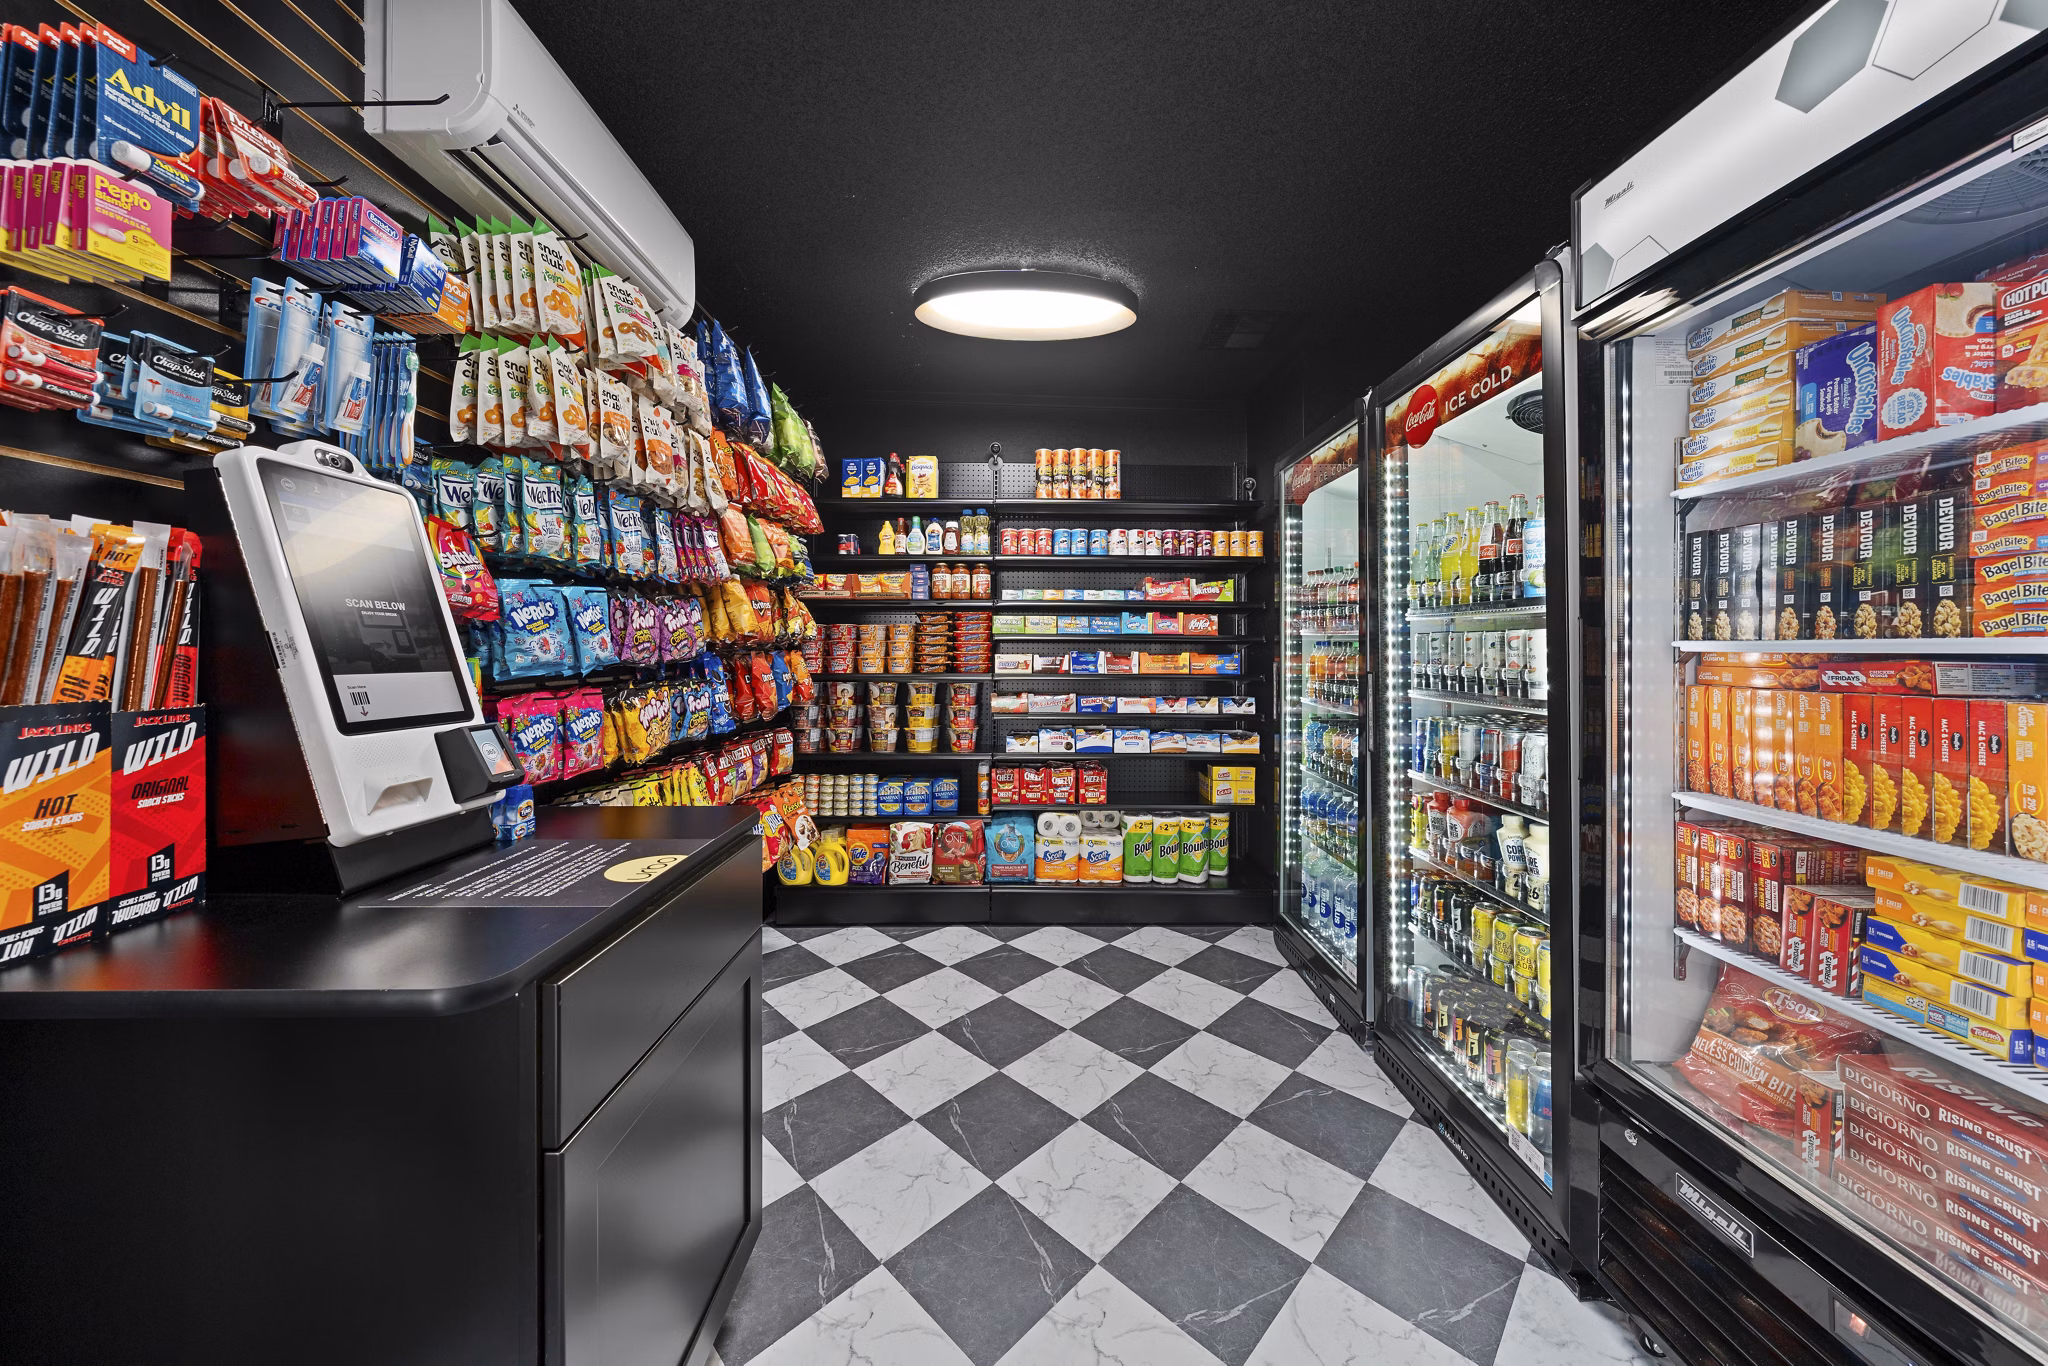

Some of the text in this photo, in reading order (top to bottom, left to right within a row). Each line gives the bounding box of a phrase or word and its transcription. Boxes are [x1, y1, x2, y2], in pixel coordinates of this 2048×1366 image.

[105, 67, 191, 131] Advil
[223, 106, 283, 154] TYLENOL
[94, 174, 152, 211] Pepto
[94, 190, 133, 212] Bismol
[95, 206, 151, 234] CHEWABLES
[367, 211, 398, 239] Benadryl
[444, 279, 467, 301] ayQuil
[16, 311, 88, 344] ChapStick
[2004, 309, 2023, 320] HAM
[2004, 309, 2043, 326] CHEDDAR
[334, 319, 371, 338] Crest
[212, 386, 243, 402] apStick
[1444, 365, 1512, 415] ICE COLD
[1897, 394, 1906, 424] BREAD
[1978, 456, 2028, 477] Bagel Bites
[1977, 483, 2027, 503] Bagel Bites
[1938, 497, 1954, 551] DEVOUR
[1982, 500, 2048, 529] Bagel Bite
[1821, 514, 1835, 562] DEVOUR
[1859, 509, 1873, 559] DEVOUR
[1903, 503, 1917, 555] DEVOUR
[1692, 537, 1702, 576] DEVOUR
[1719, 533, 1729, 574] DEVOUR
[1742, 529, 1752, 572] DEVOUR
[1770, 527, 1778, 569] DEVOUR
[1785, 520, 1798, 566] DEVOUR
[1976, 535, 2028, 554] Bagel Bites
[104, 550, 133, 564] HOT
[1983, 557, 2022, 578] Bagel
[345, 598, 406, 611] SCAN BELOW
[1148, 587, 1174, 595] Skittles
[1982, 586, 2021, 606] Bagel
[1981, 614, 2020, 633] Bagel
[1831, 674, 1861, 682] FRIDAYS
[18, 724, 55, 739] JACK
[2018, 706, 2028, 737] Cuisine
[3, 732, 101, 794] WILD
[1941, 739, 1949, 763] CHEESE
[1978, 742, 1986, 766] CHEESE
[1217, 788, 1232, 796] GLAD
[34, 793, 79, 819] HOT
[945, 834, 965, 843] ONE
[851, 848, 868, 859] Tide
[891, 855, 929, 873] Beneful
[1045, 852, 1064, 861] Scott
[39, 883, 63, 903] 13g
[1773, 989, 1821, 1019] Tyson
[2014, 1040, 2024, 1050] 15
[1692, 1035, 1797, 1103] NELESS CHICKEN BITE
[1938, 1108, 1982, 1135] RISING
[1986, 1130, 2032, 1165] CRUST
[1946, 1141, 2042, 1202] RISING CRUST
[1945, 1170, 2040, 1233] RISING CRUST
[1946, 1199, 2041, 1265] RISING CRUST
[1935, 1226, 2030, 1295] RISING CRUST
